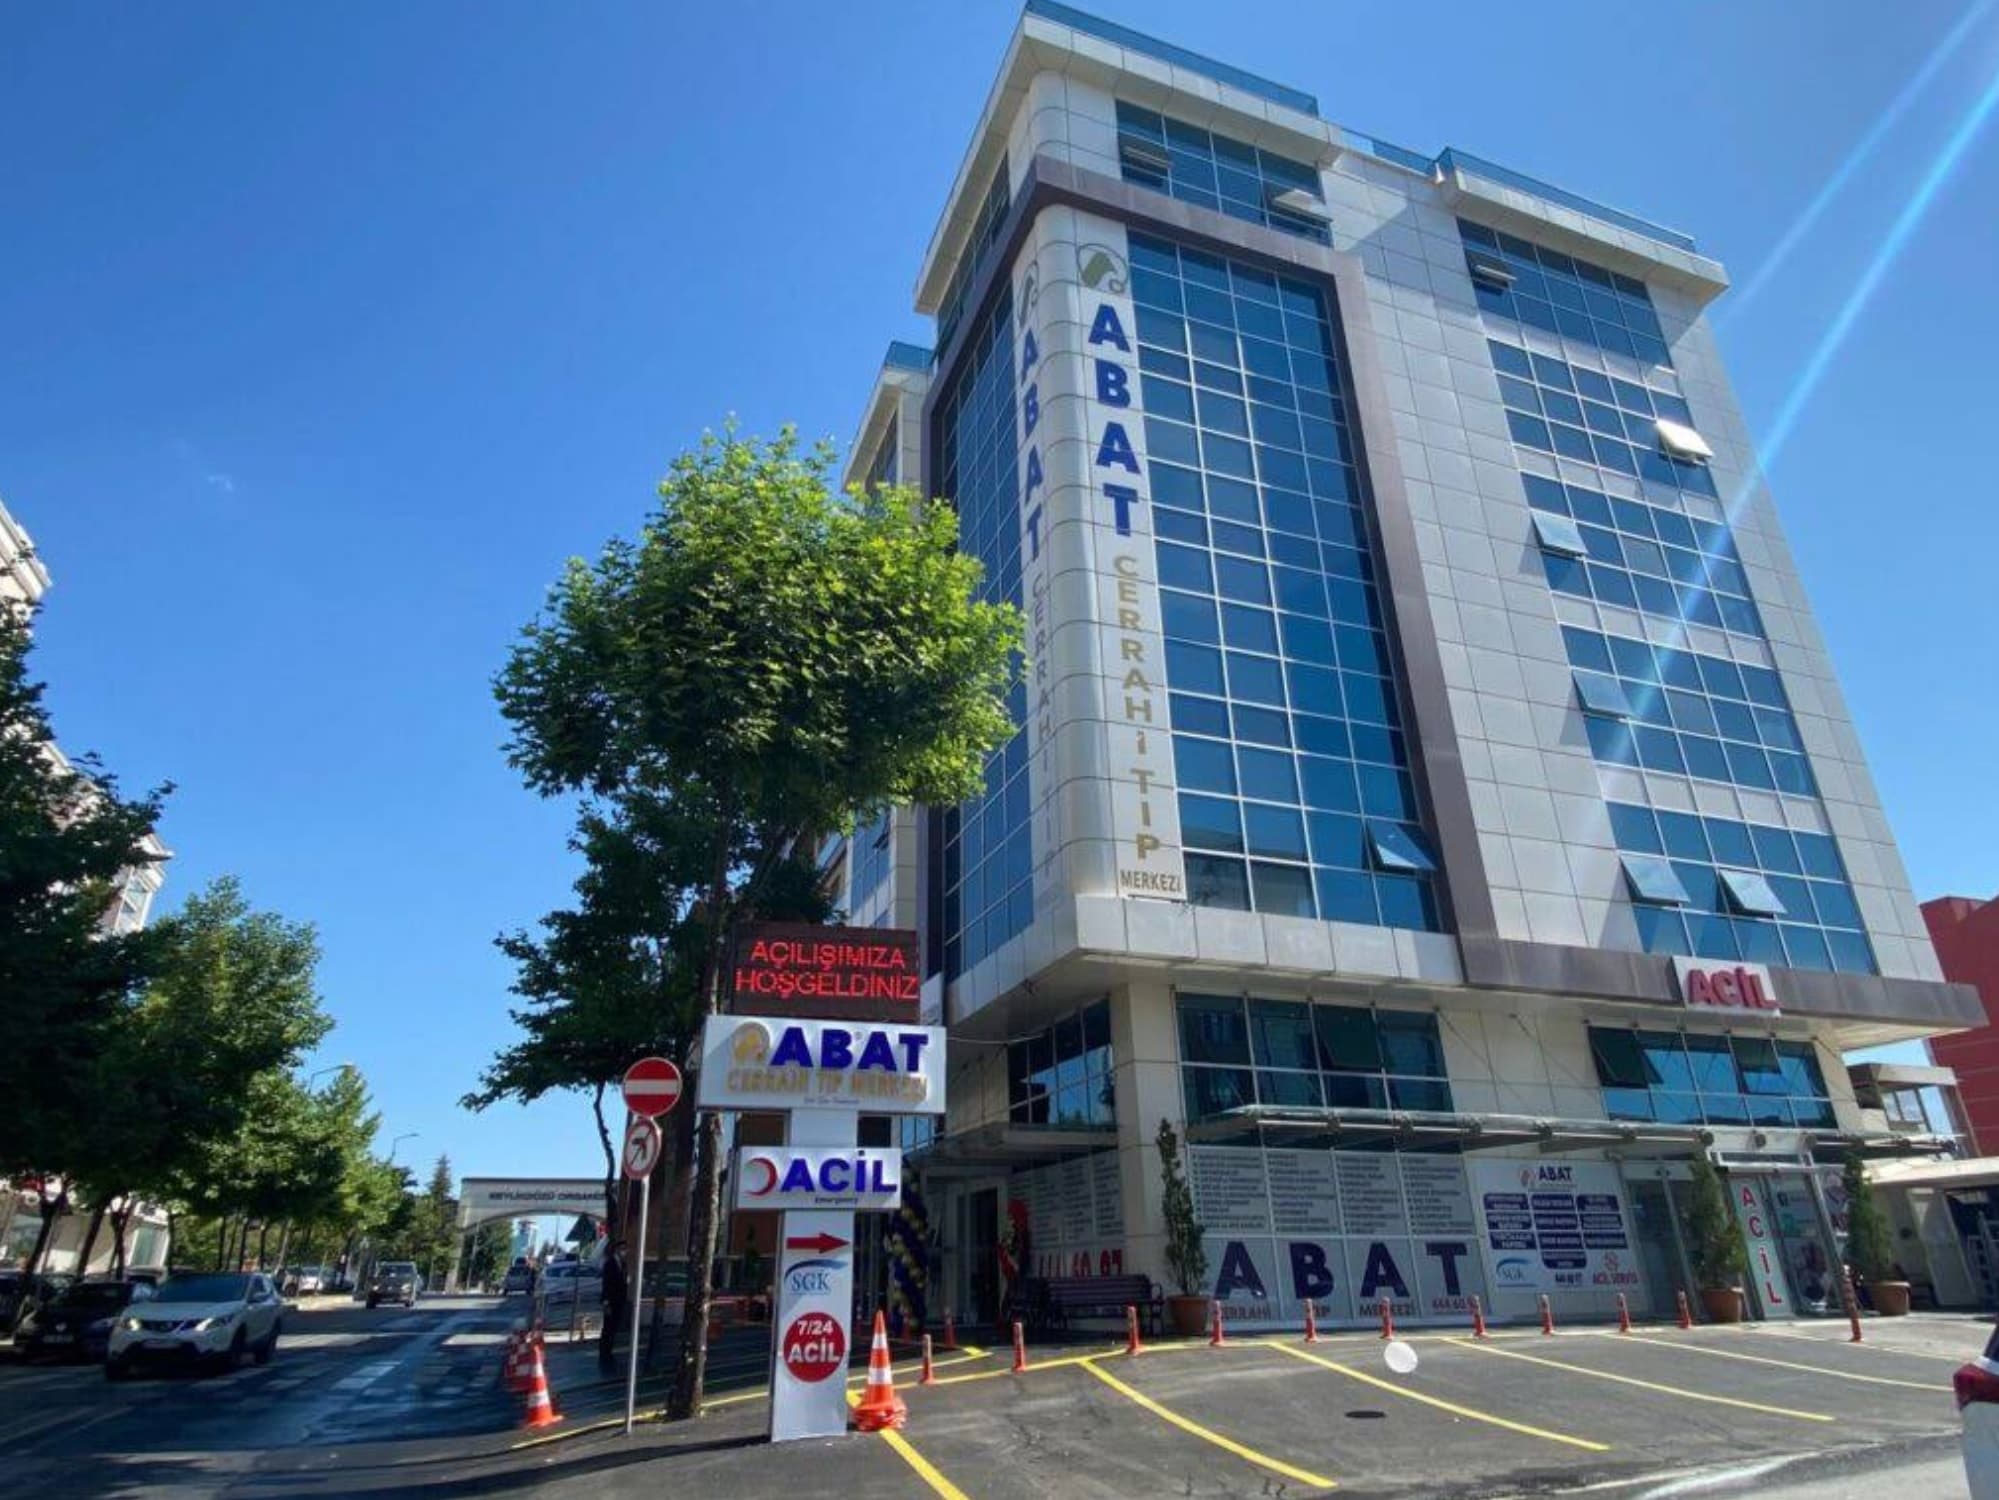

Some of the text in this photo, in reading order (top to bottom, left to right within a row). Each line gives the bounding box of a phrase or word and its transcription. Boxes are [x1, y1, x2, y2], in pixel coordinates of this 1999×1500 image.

[1089, 303, 1142, 538] ABAT
[1020, 327, 1043, 562] ABAT
[1129, 767, 1162, 860] TIP
[1687, 966, 1784, 1010] ACİL
[769, 1026, 929, 1073] ABAT
[780, 1151, 898, 1193] ACİL
[1538, 1166, 1573, 1181] ABAT
[1740, 1186, 1782, 1305] ACİL
[791, 1270, 832, 1293] SGK
[1214, 1240, 1469, 1300] ABAT
[788, 1337, 841, 1364] ACİL
[797, 1320, 834, 1336] 7/24
